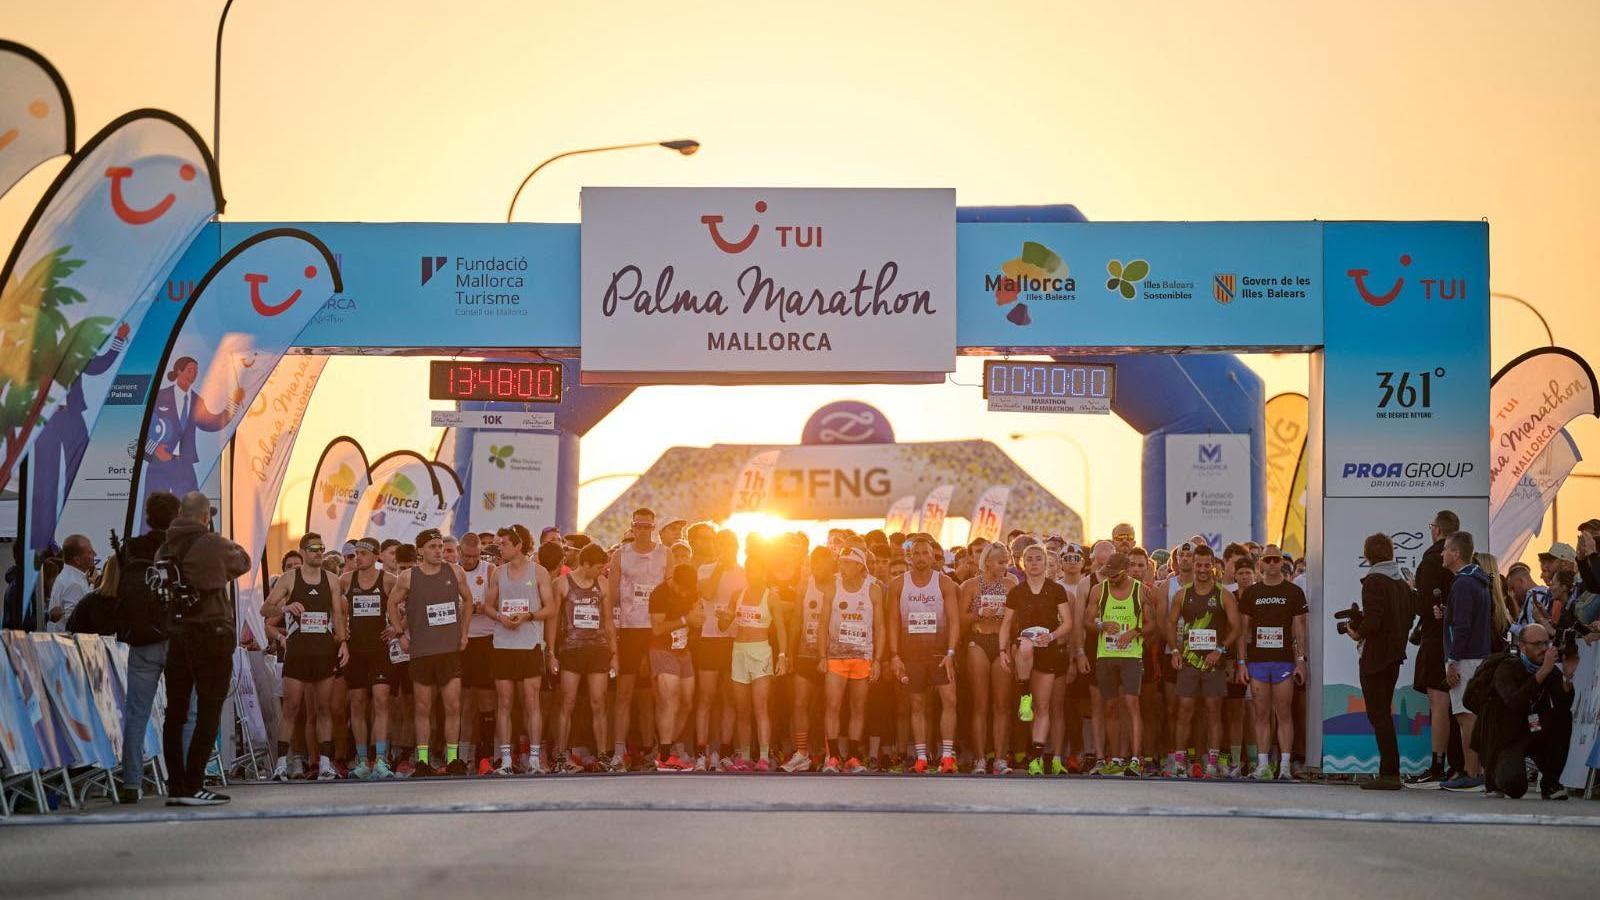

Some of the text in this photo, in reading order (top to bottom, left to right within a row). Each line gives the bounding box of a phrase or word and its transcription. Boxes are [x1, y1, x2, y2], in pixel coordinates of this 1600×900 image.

[776, 226, 822, 247] TUI
[456, 256, 528, 271] Fundació
[456, 274, 524, 288] Mallorca
[985, 274, 1077, 292] Mallorca
[1144, 281, 1194, 289] Illes Balears
[1242, 276, 1310, 286] Govern de les
[602, 261, 936, 323] Palma Marathon
[1143, 291, 1193, 300] Sostenibles
[1242, 289, 1305, 298] Illes Balears
[1420, 279, 1466, 300] TUI
[456, 291, 520, 305] Turisme
[1026, 293, 1076, 301] Illes Balears
[708, 332, 832, 351] MALLORCA
[449, 367, 553, 397] 13:48:00
[1496, 398, 1520, 419] TUI
[1500, 379, 1588, 452] Marathon
[483, 415, 503, 425] 10K
[1511, 424, 1556, 478] MALLORCA
[108, 466, 126, 474] Port
[808, 467, 891, 498] FNG
[1370, 480, 1445, 488] DRIVING DREAMS
[1255, 597, 1287, 605] BROOKS
